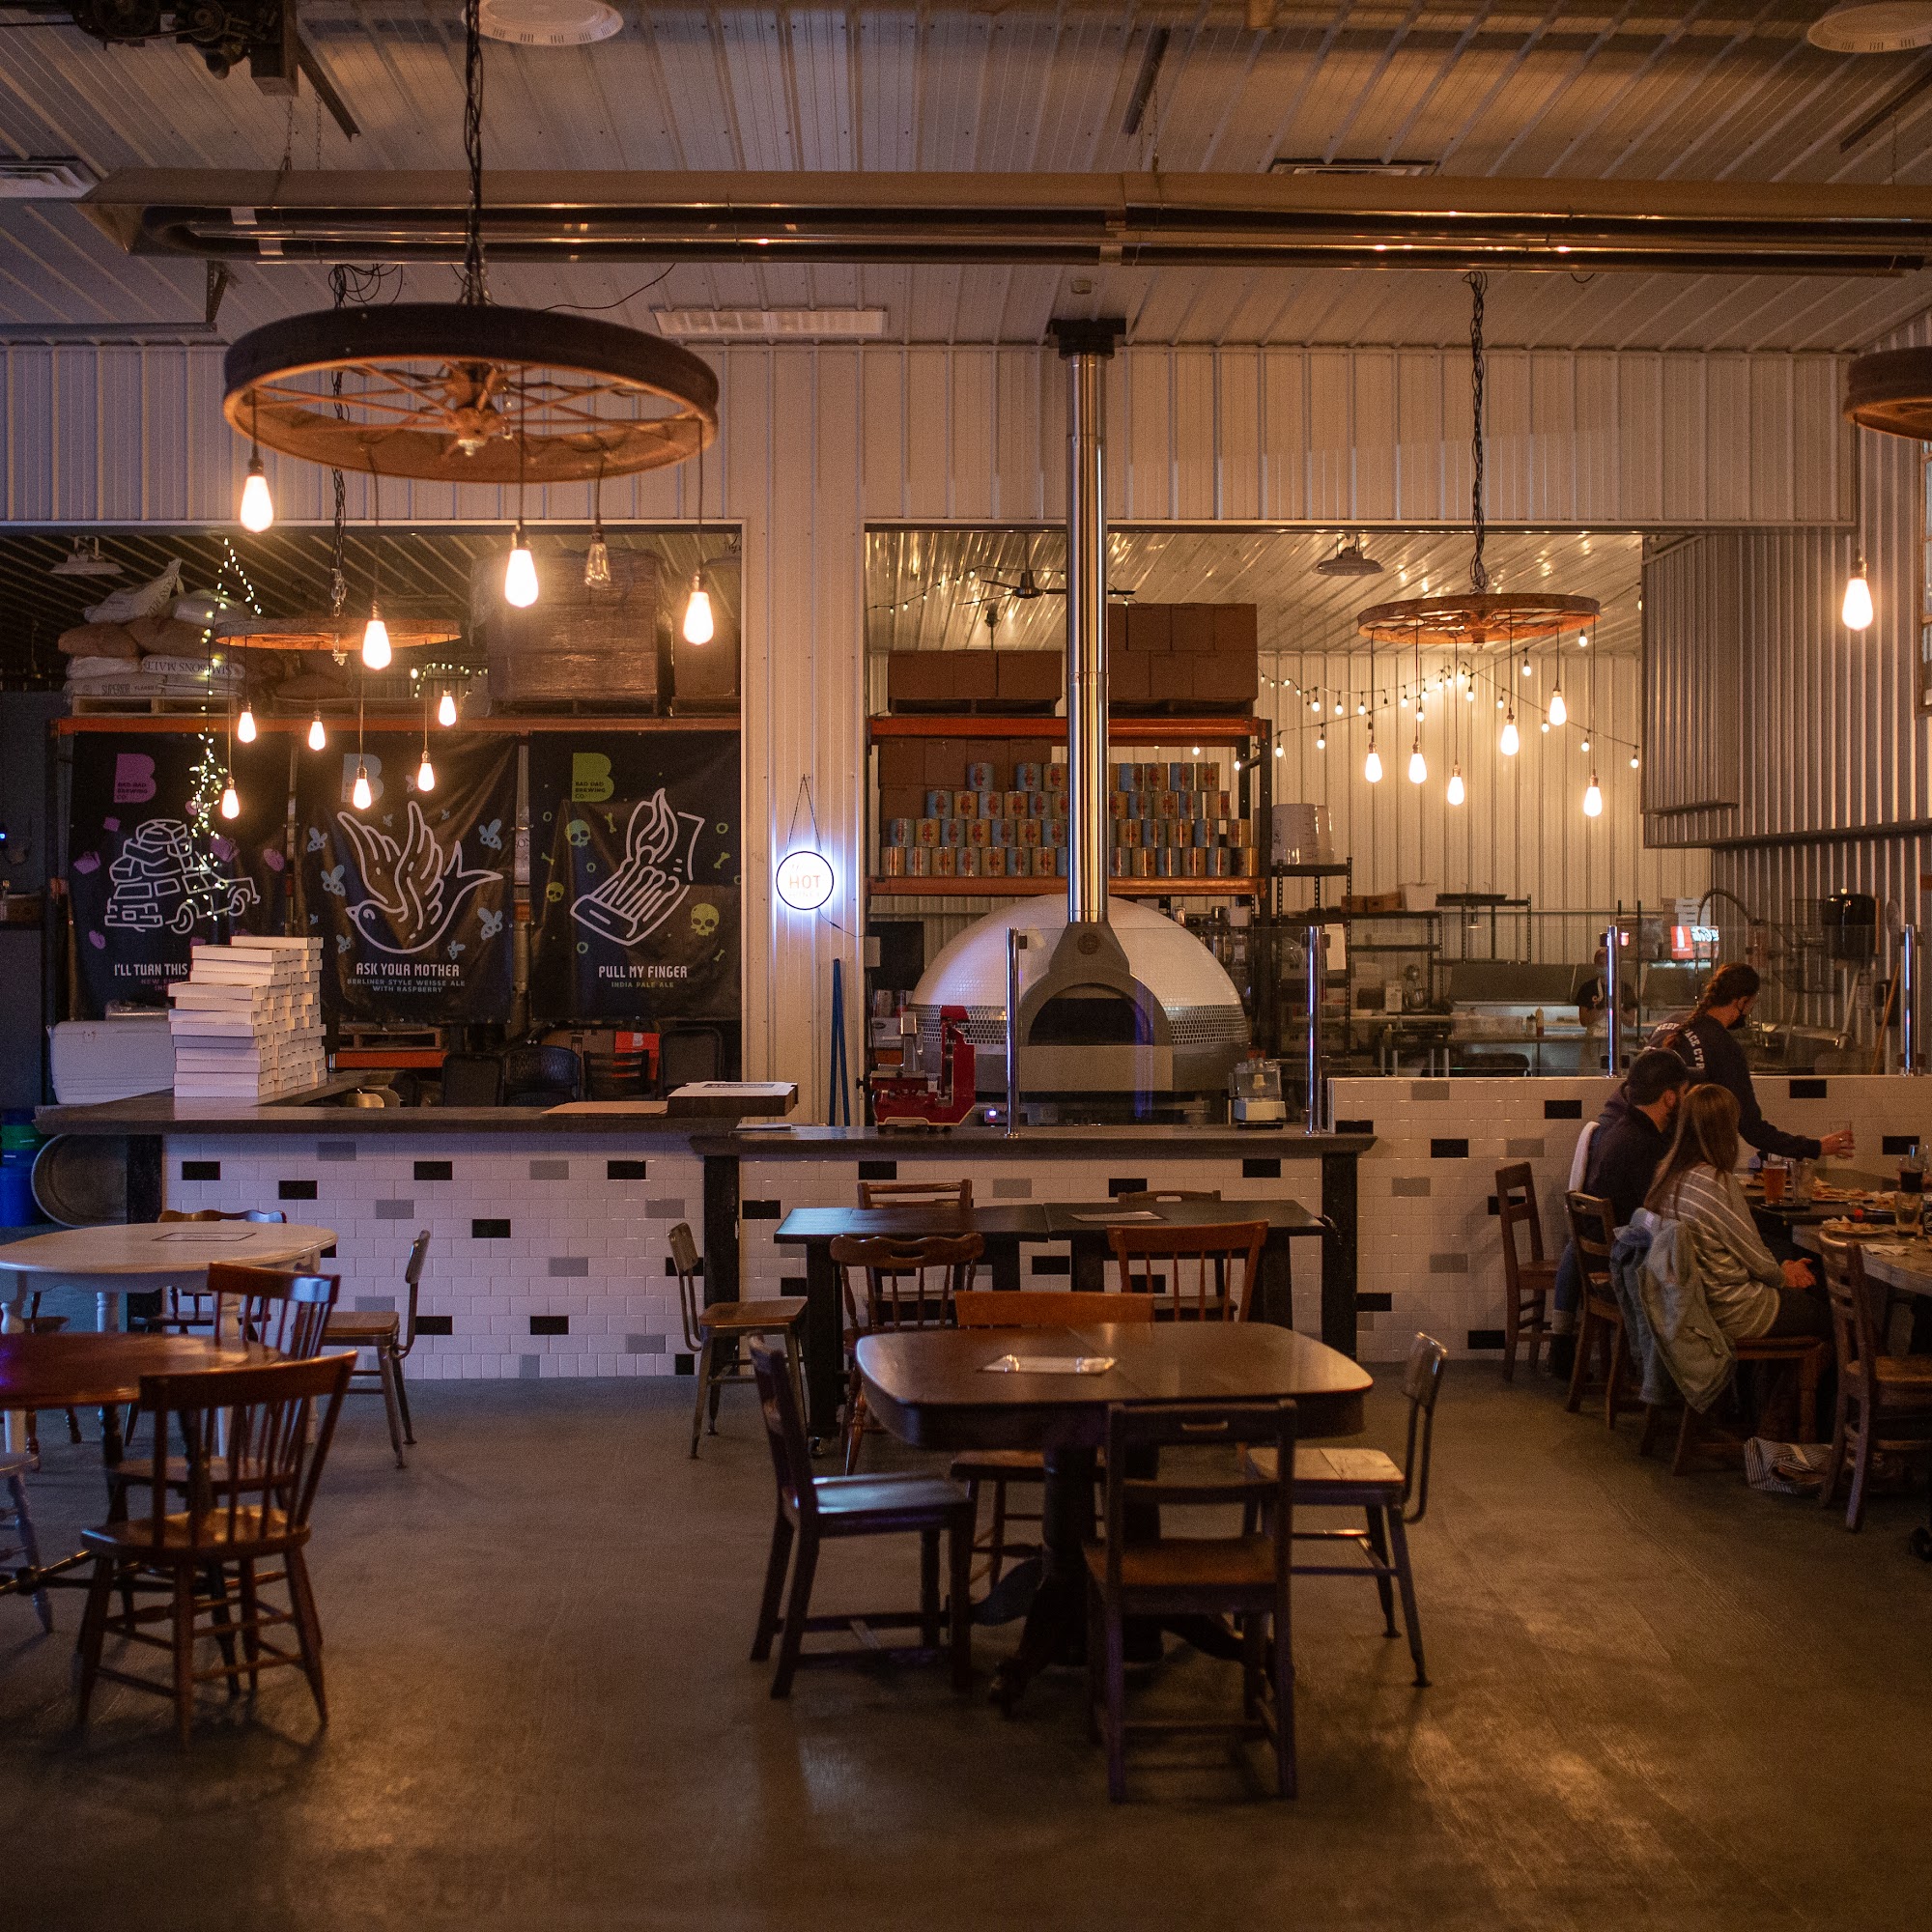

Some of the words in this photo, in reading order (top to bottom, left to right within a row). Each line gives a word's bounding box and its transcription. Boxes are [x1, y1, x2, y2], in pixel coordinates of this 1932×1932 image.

[788, 874, 821, 889] HOT
[114, 963, 131, 977] I'LL
[133, 963, 162, 977] TURN
[164, 962, 188, 976] THIS
[355, 962, 379, 976] ASK
[381, 962, 412, 977] YOUR
[413, 963, 460, 978] MOTHER
[598, 965, 626, 978] PULL
[629, 965, 644, 978] MY
[647, 965, 688, 978] FINGER
